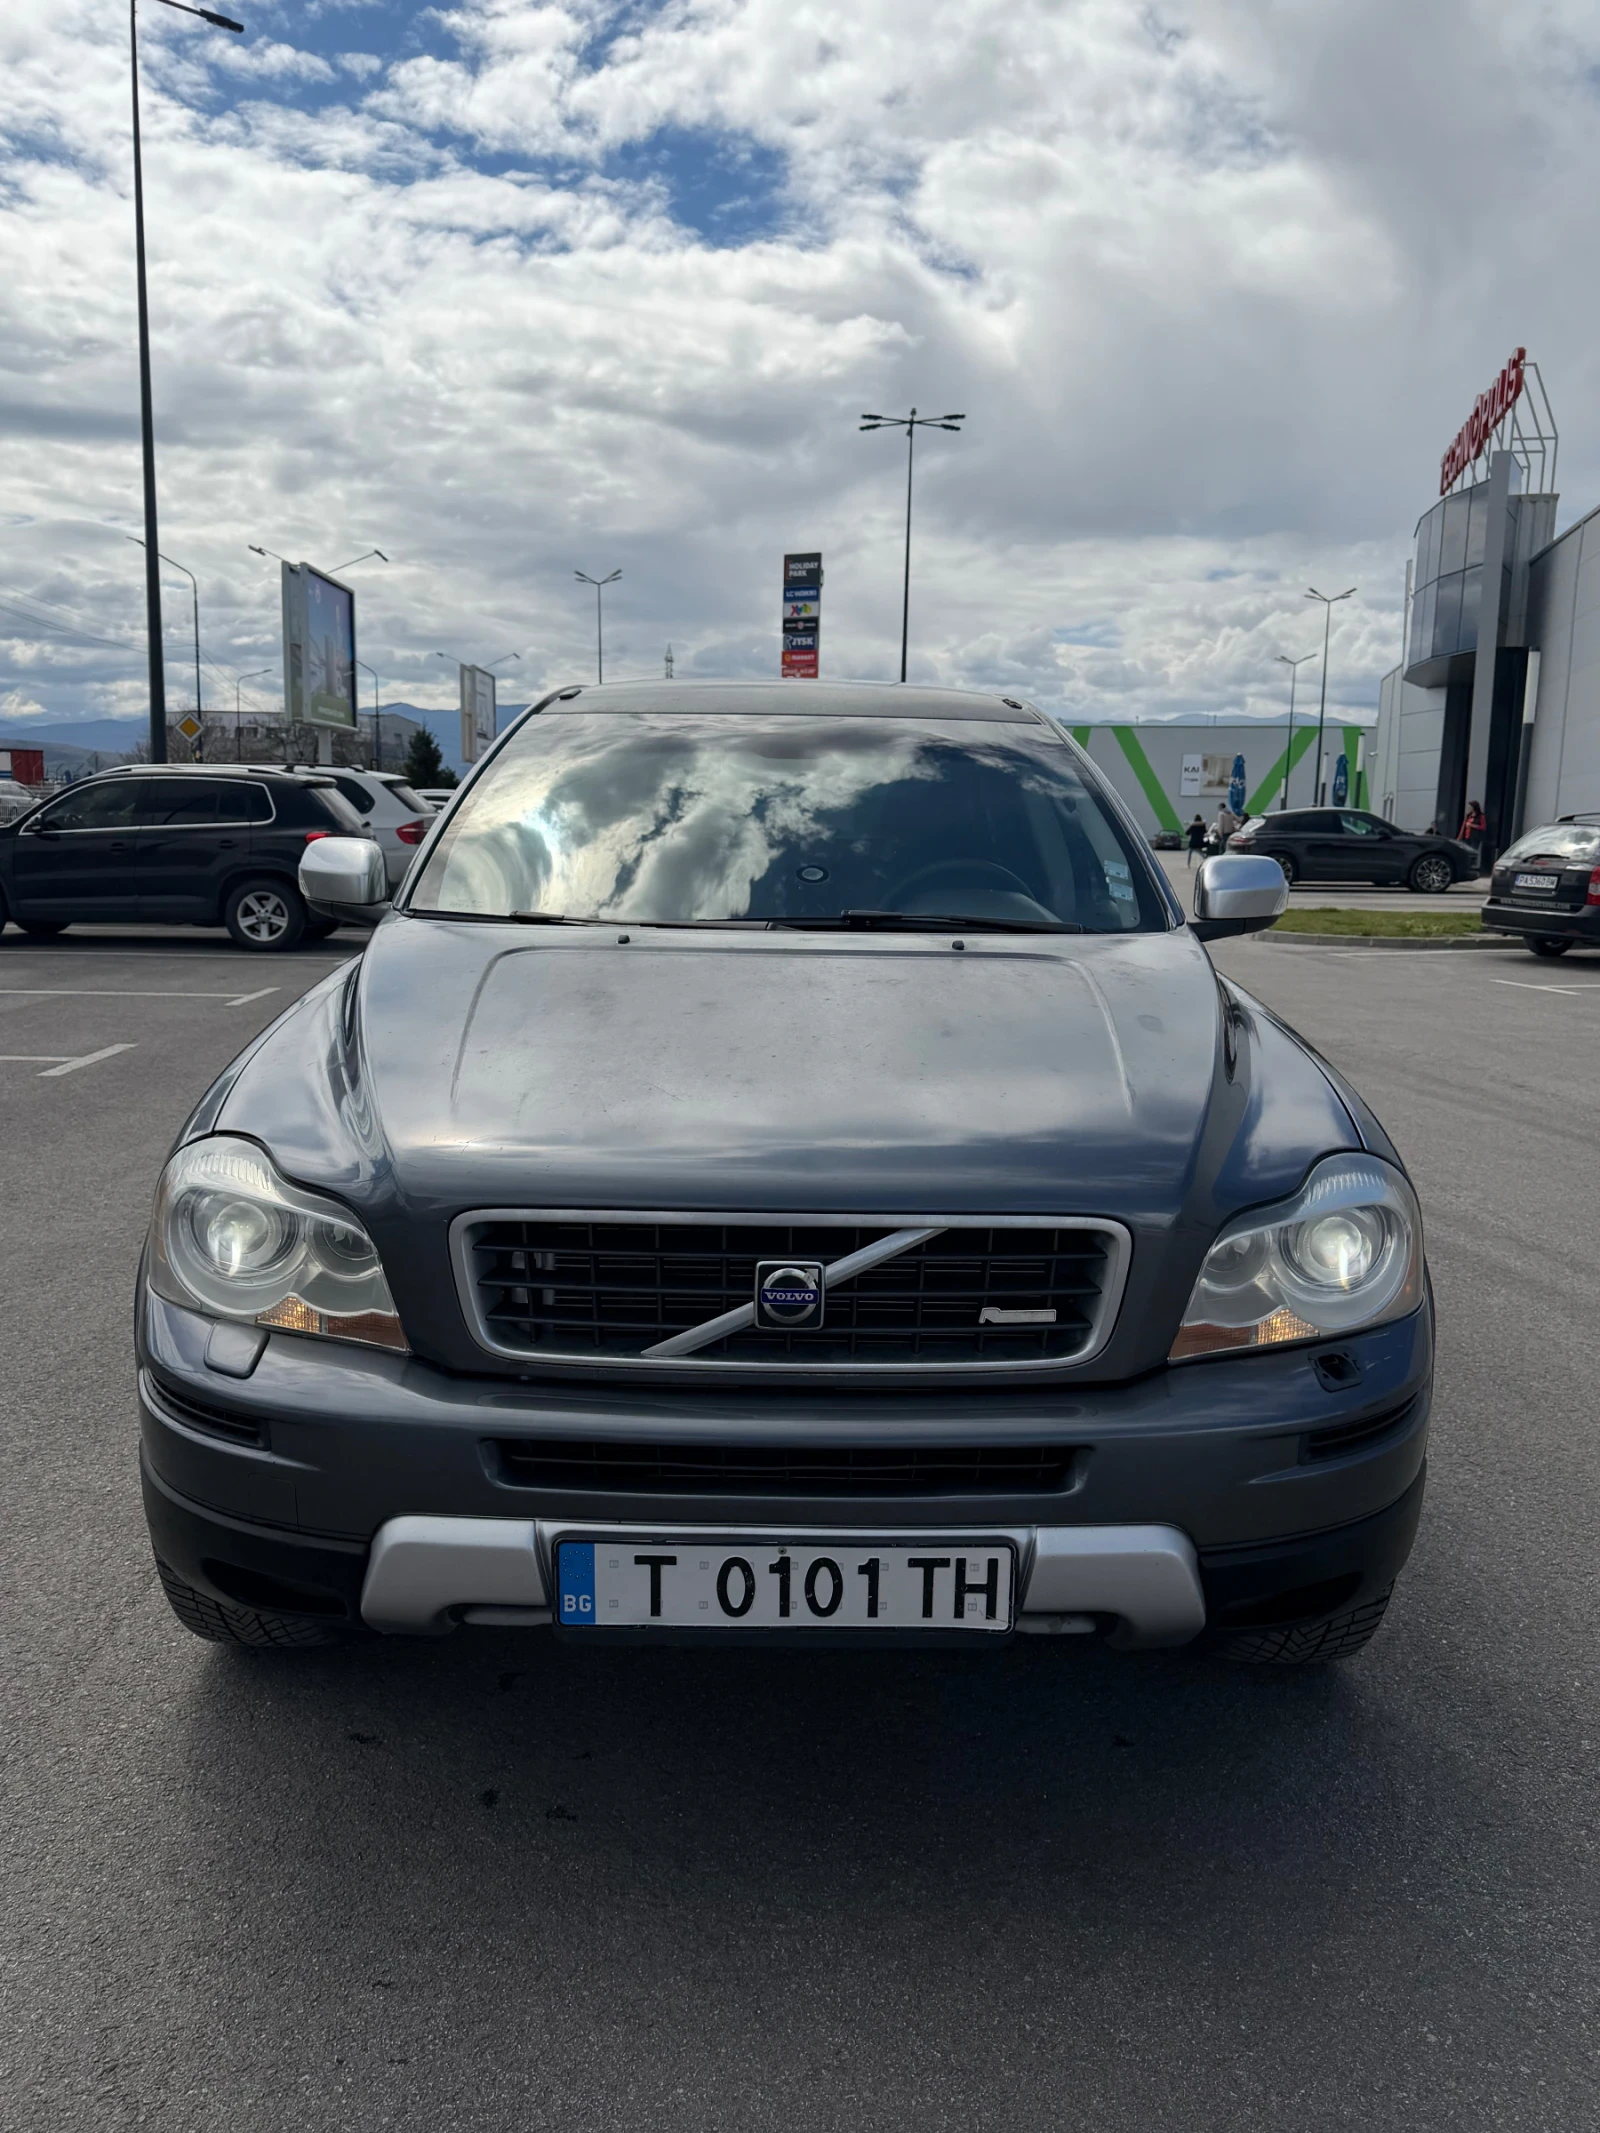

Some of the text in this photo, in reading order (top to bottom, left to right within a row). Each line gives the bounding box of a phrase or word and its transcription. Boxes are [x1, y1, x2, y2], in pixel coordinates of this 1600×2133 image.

[788, 562, 819, 570] HOLIDAY
[792, 637, 814, 646] JYSK
[764, 1291, 815, 1301] VOLVO
[633, 1554, 1000, 1620] T 0101 TH
[563, 1594, 592, 1613] BG
